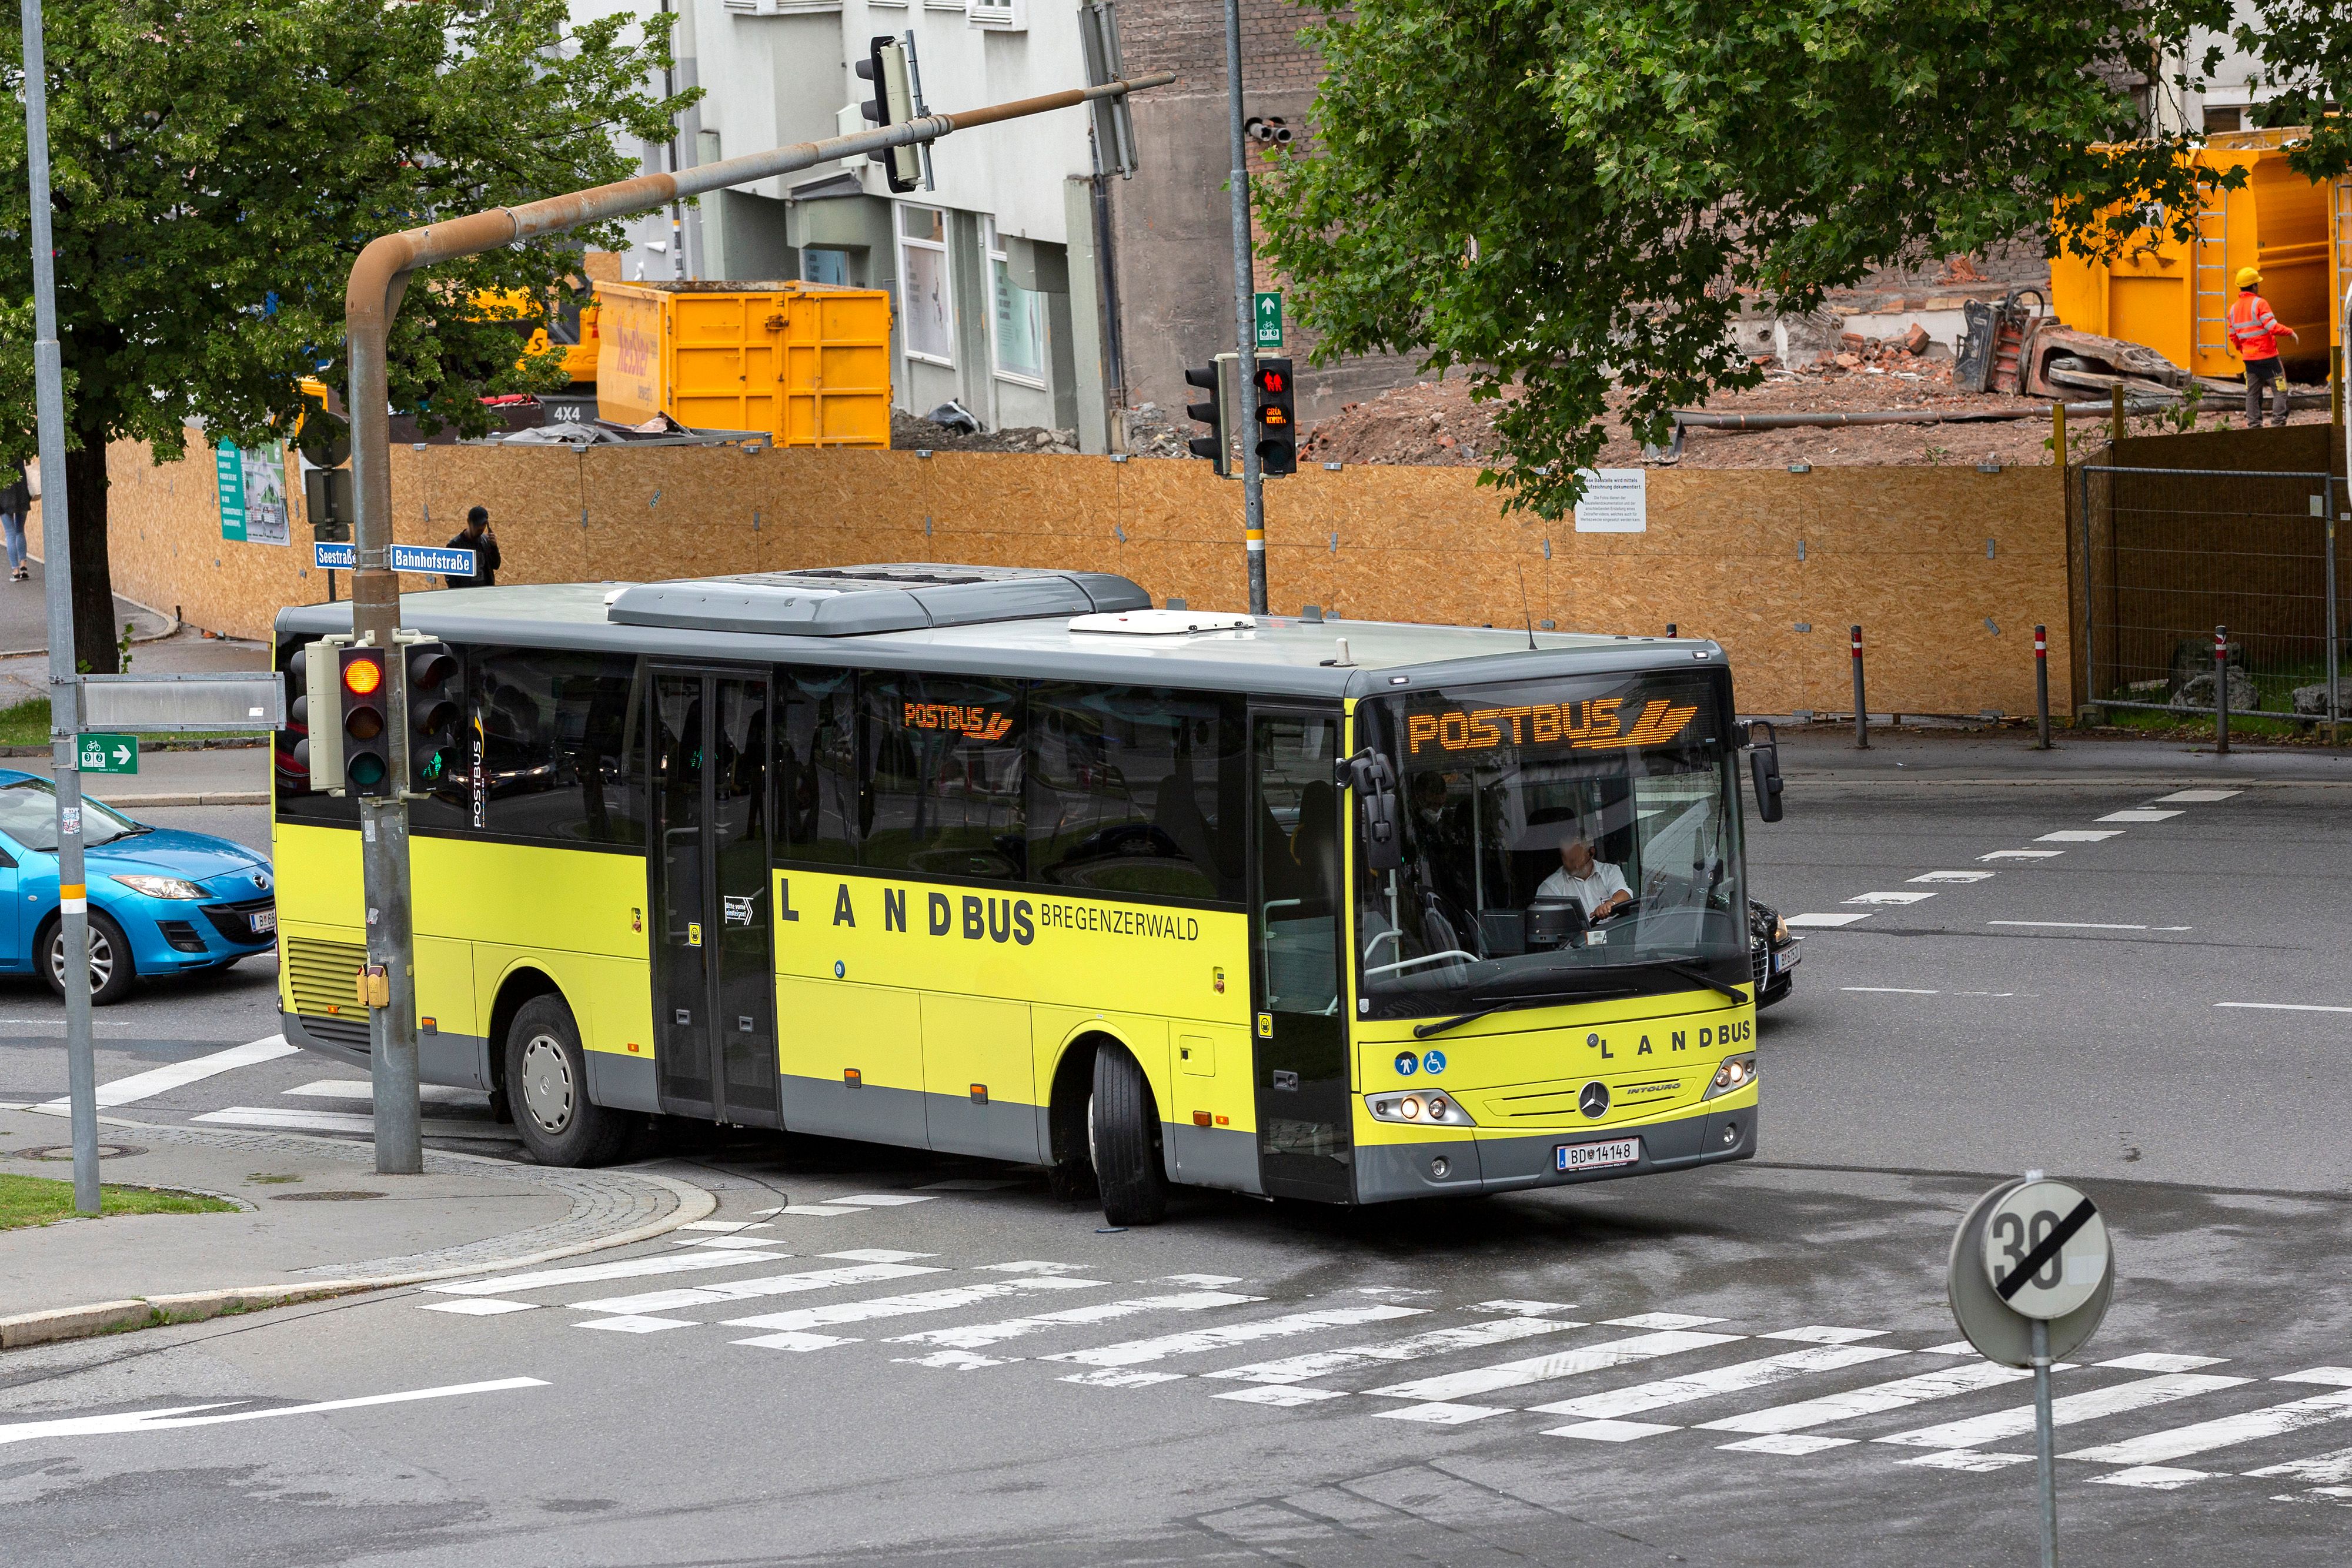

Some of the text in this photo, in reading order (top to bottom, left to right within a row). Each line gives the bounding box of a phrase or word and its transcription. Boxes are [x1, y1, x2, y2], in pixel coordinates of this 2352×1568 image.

[554, 406, 580, 420] 4X4
[318, 547, 356, 564] Seestraße
[395, 549, 470, 571] Bahnhofstraße
[904, 703, 984, 731] POSTBUS
[1409, 698, 1623, 754] POSTBUS
[473, 740, 482, 828] POSTBUS
[259, 915, 263, 927] B
[781, 877, 1199, 946] LANDBUS BREGENZERWALD
[1601, 1019, 1750, 1059] LANDBUS
[1627, 1082, 1681, 1094] INTOURO
[1571, 1149, 1586, 1164] BD
[1596, 1144, 1631, 1161] 14148
[1993, 1210, 2062, 1290] 30
